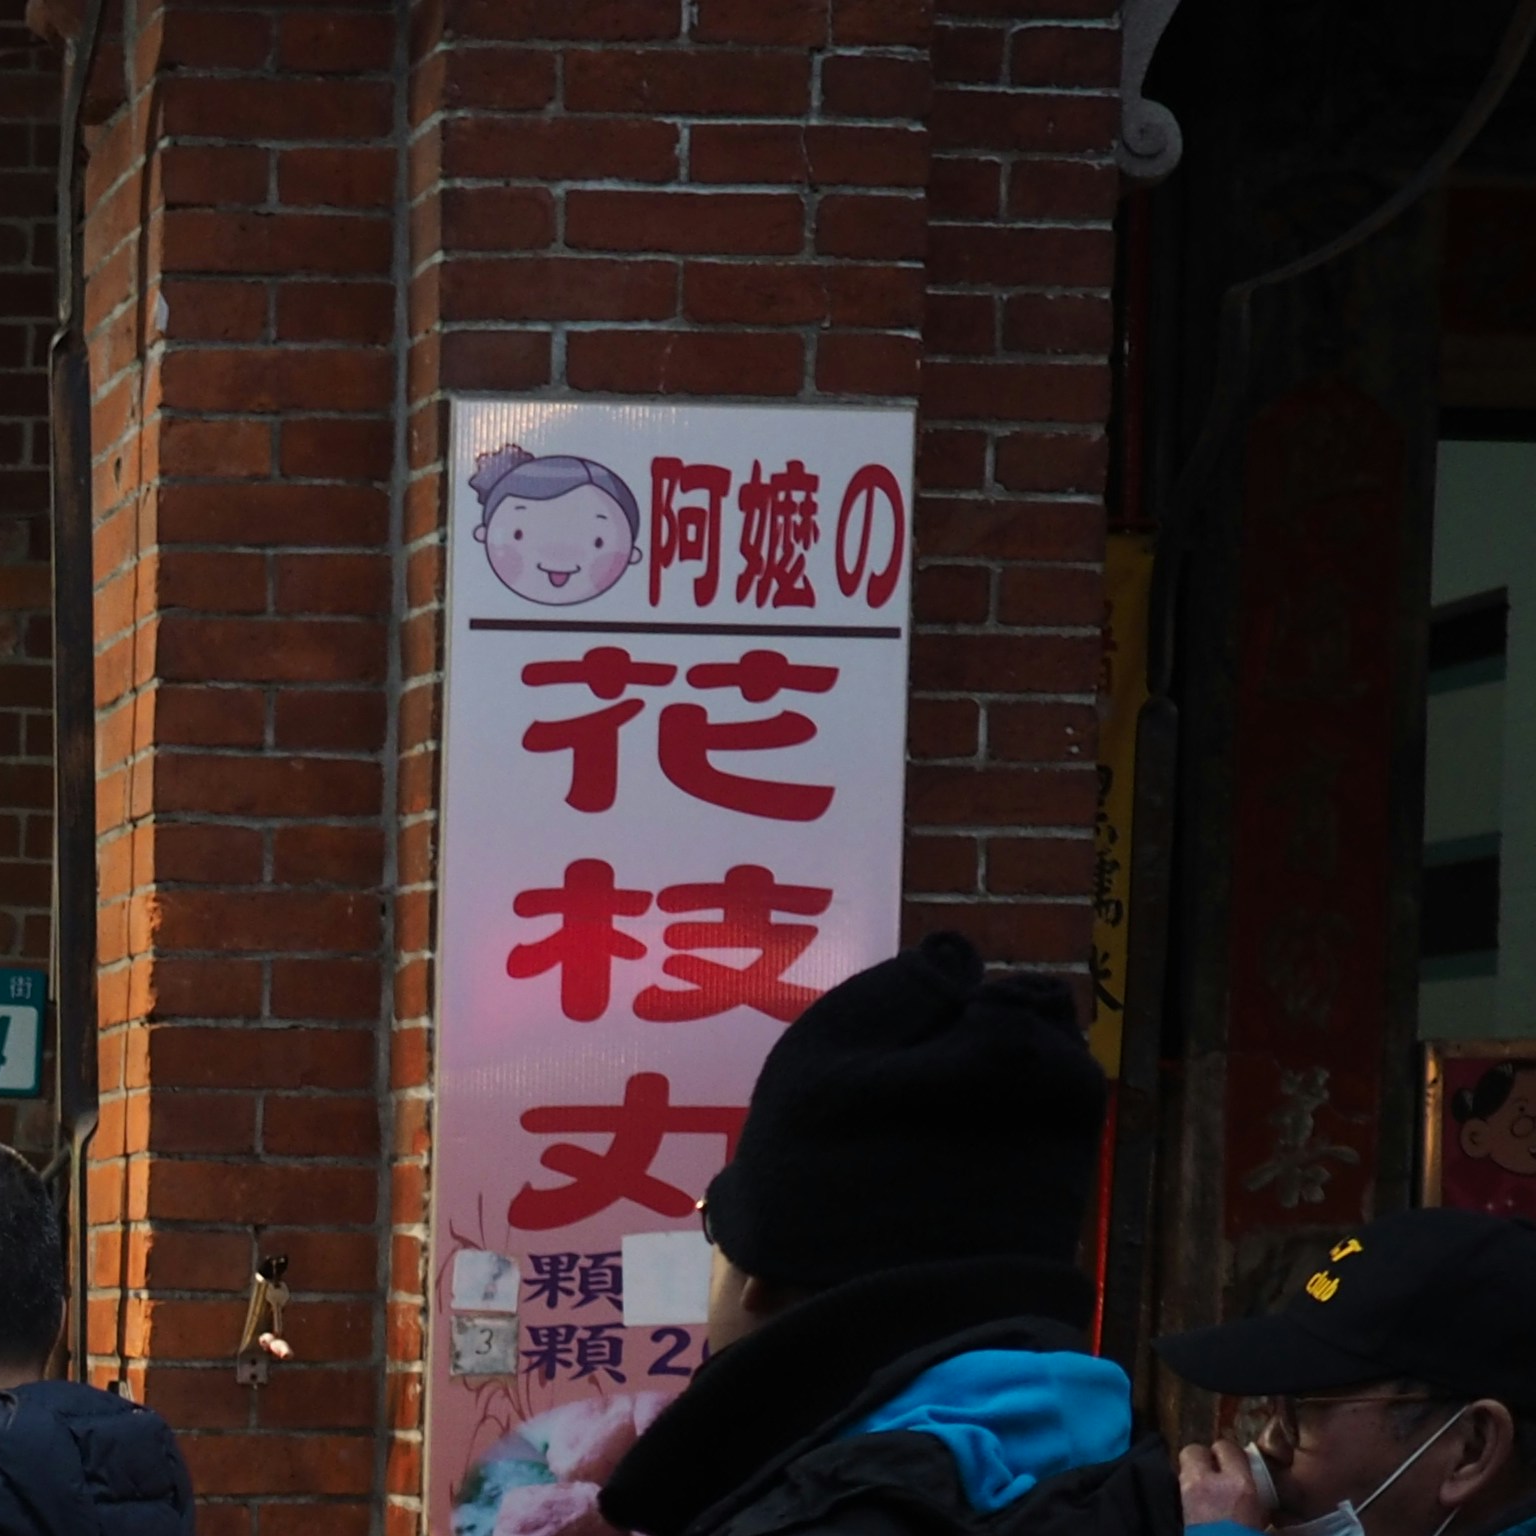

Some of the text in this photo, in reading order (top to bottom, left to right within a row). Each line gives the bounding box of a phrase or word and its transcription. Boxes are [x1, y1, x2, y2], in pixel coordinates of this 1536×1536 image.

[648, 456, 906, 609] 阿嬤の
[648, 1327, 711, 1377] 2
